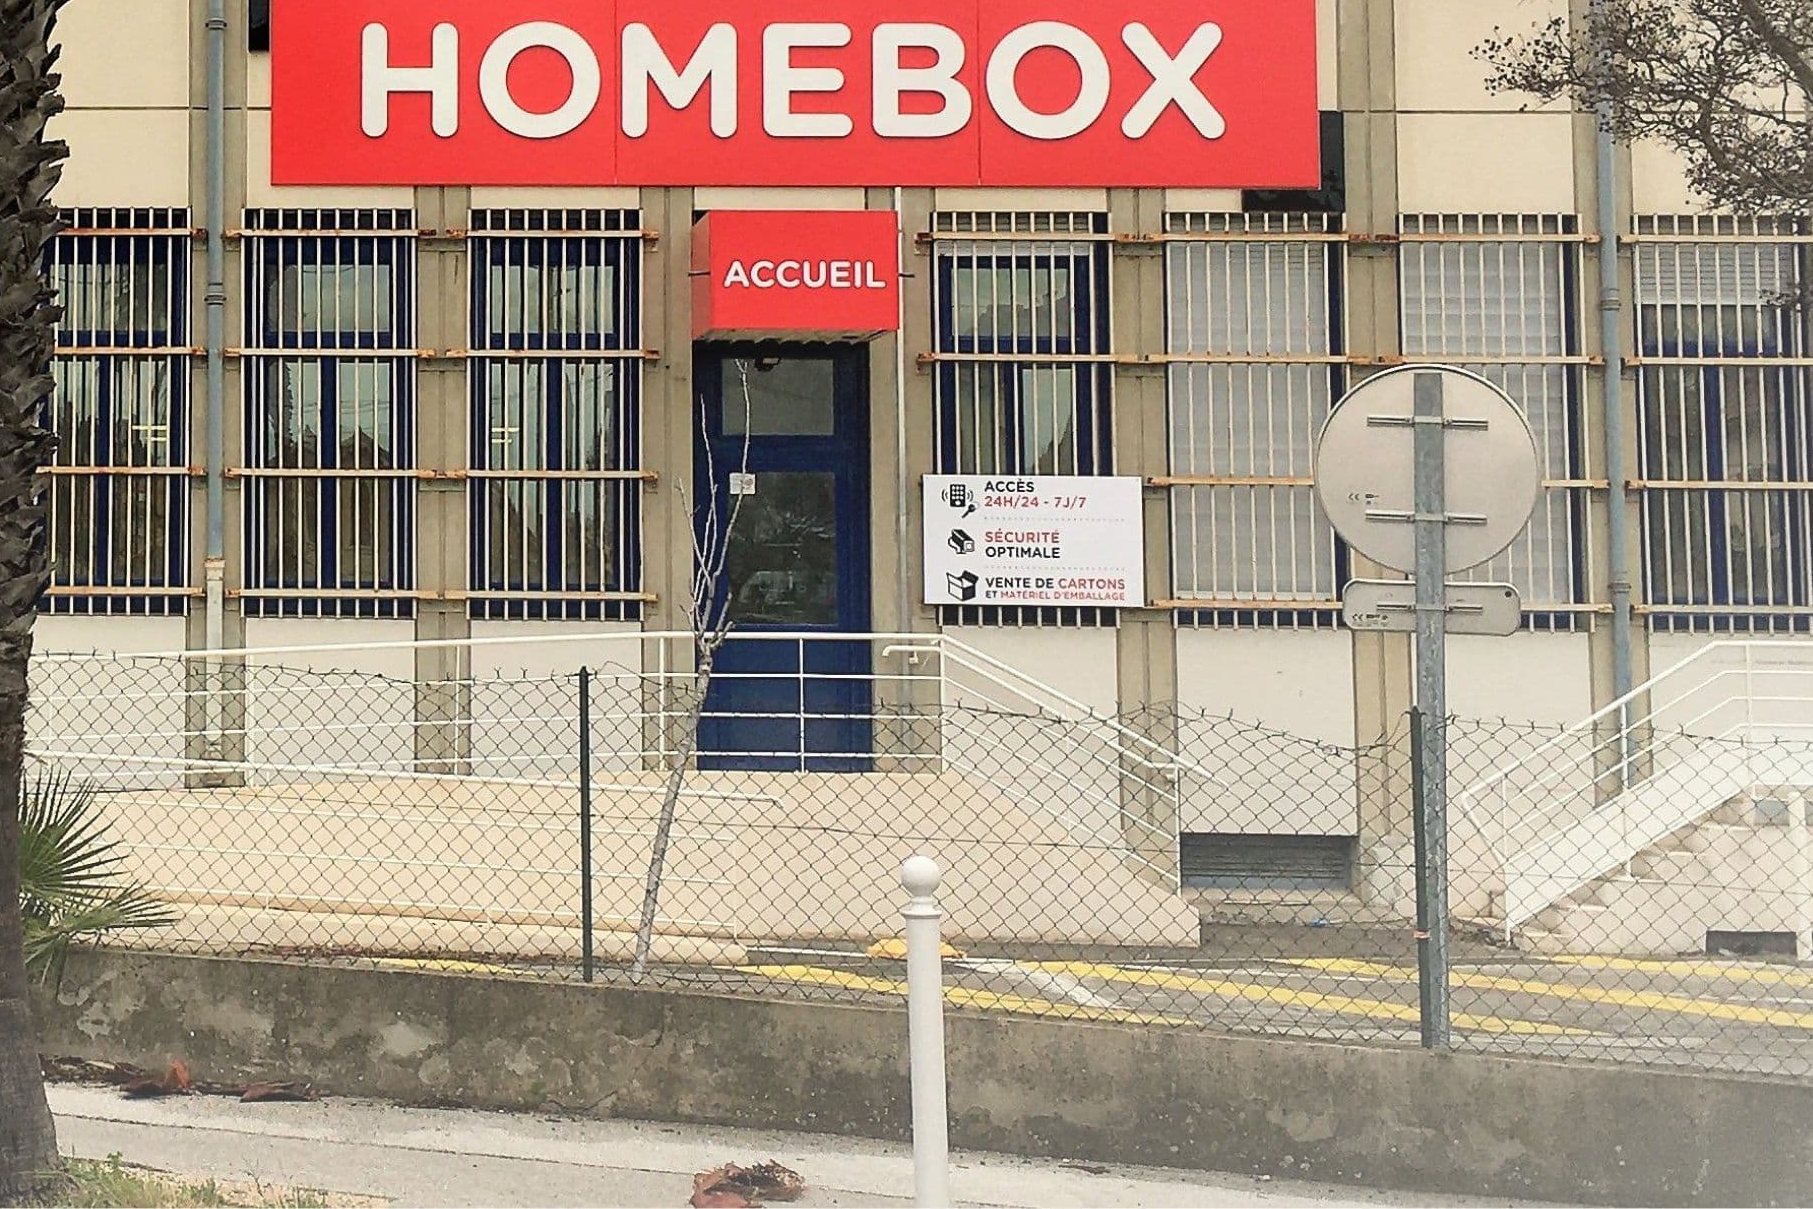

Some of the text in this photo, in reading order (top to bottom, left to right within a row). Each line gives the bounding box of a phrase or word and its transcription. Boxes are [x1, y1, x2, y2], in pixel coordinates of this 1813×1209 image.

[360, 20, 1226, 140] HOMEBOX
[723, 259, 886, 289] ACCUEIL
[984, 478, 1035, 493] ACCÈS
[984, 495, 1039, 509] 24H/24
[1054, 496, 1087, 510] 7J/7
[984, 528, 1061, 544] SÉCURITÉ
[985, 546, 1061, 559] OPTIMALE
[985, 577, 1126, 590] VENTE DE CARTONS
[985, 590, 998, 599] ET
[1054, 592, 1126, 601] D'EMBALLAGE
